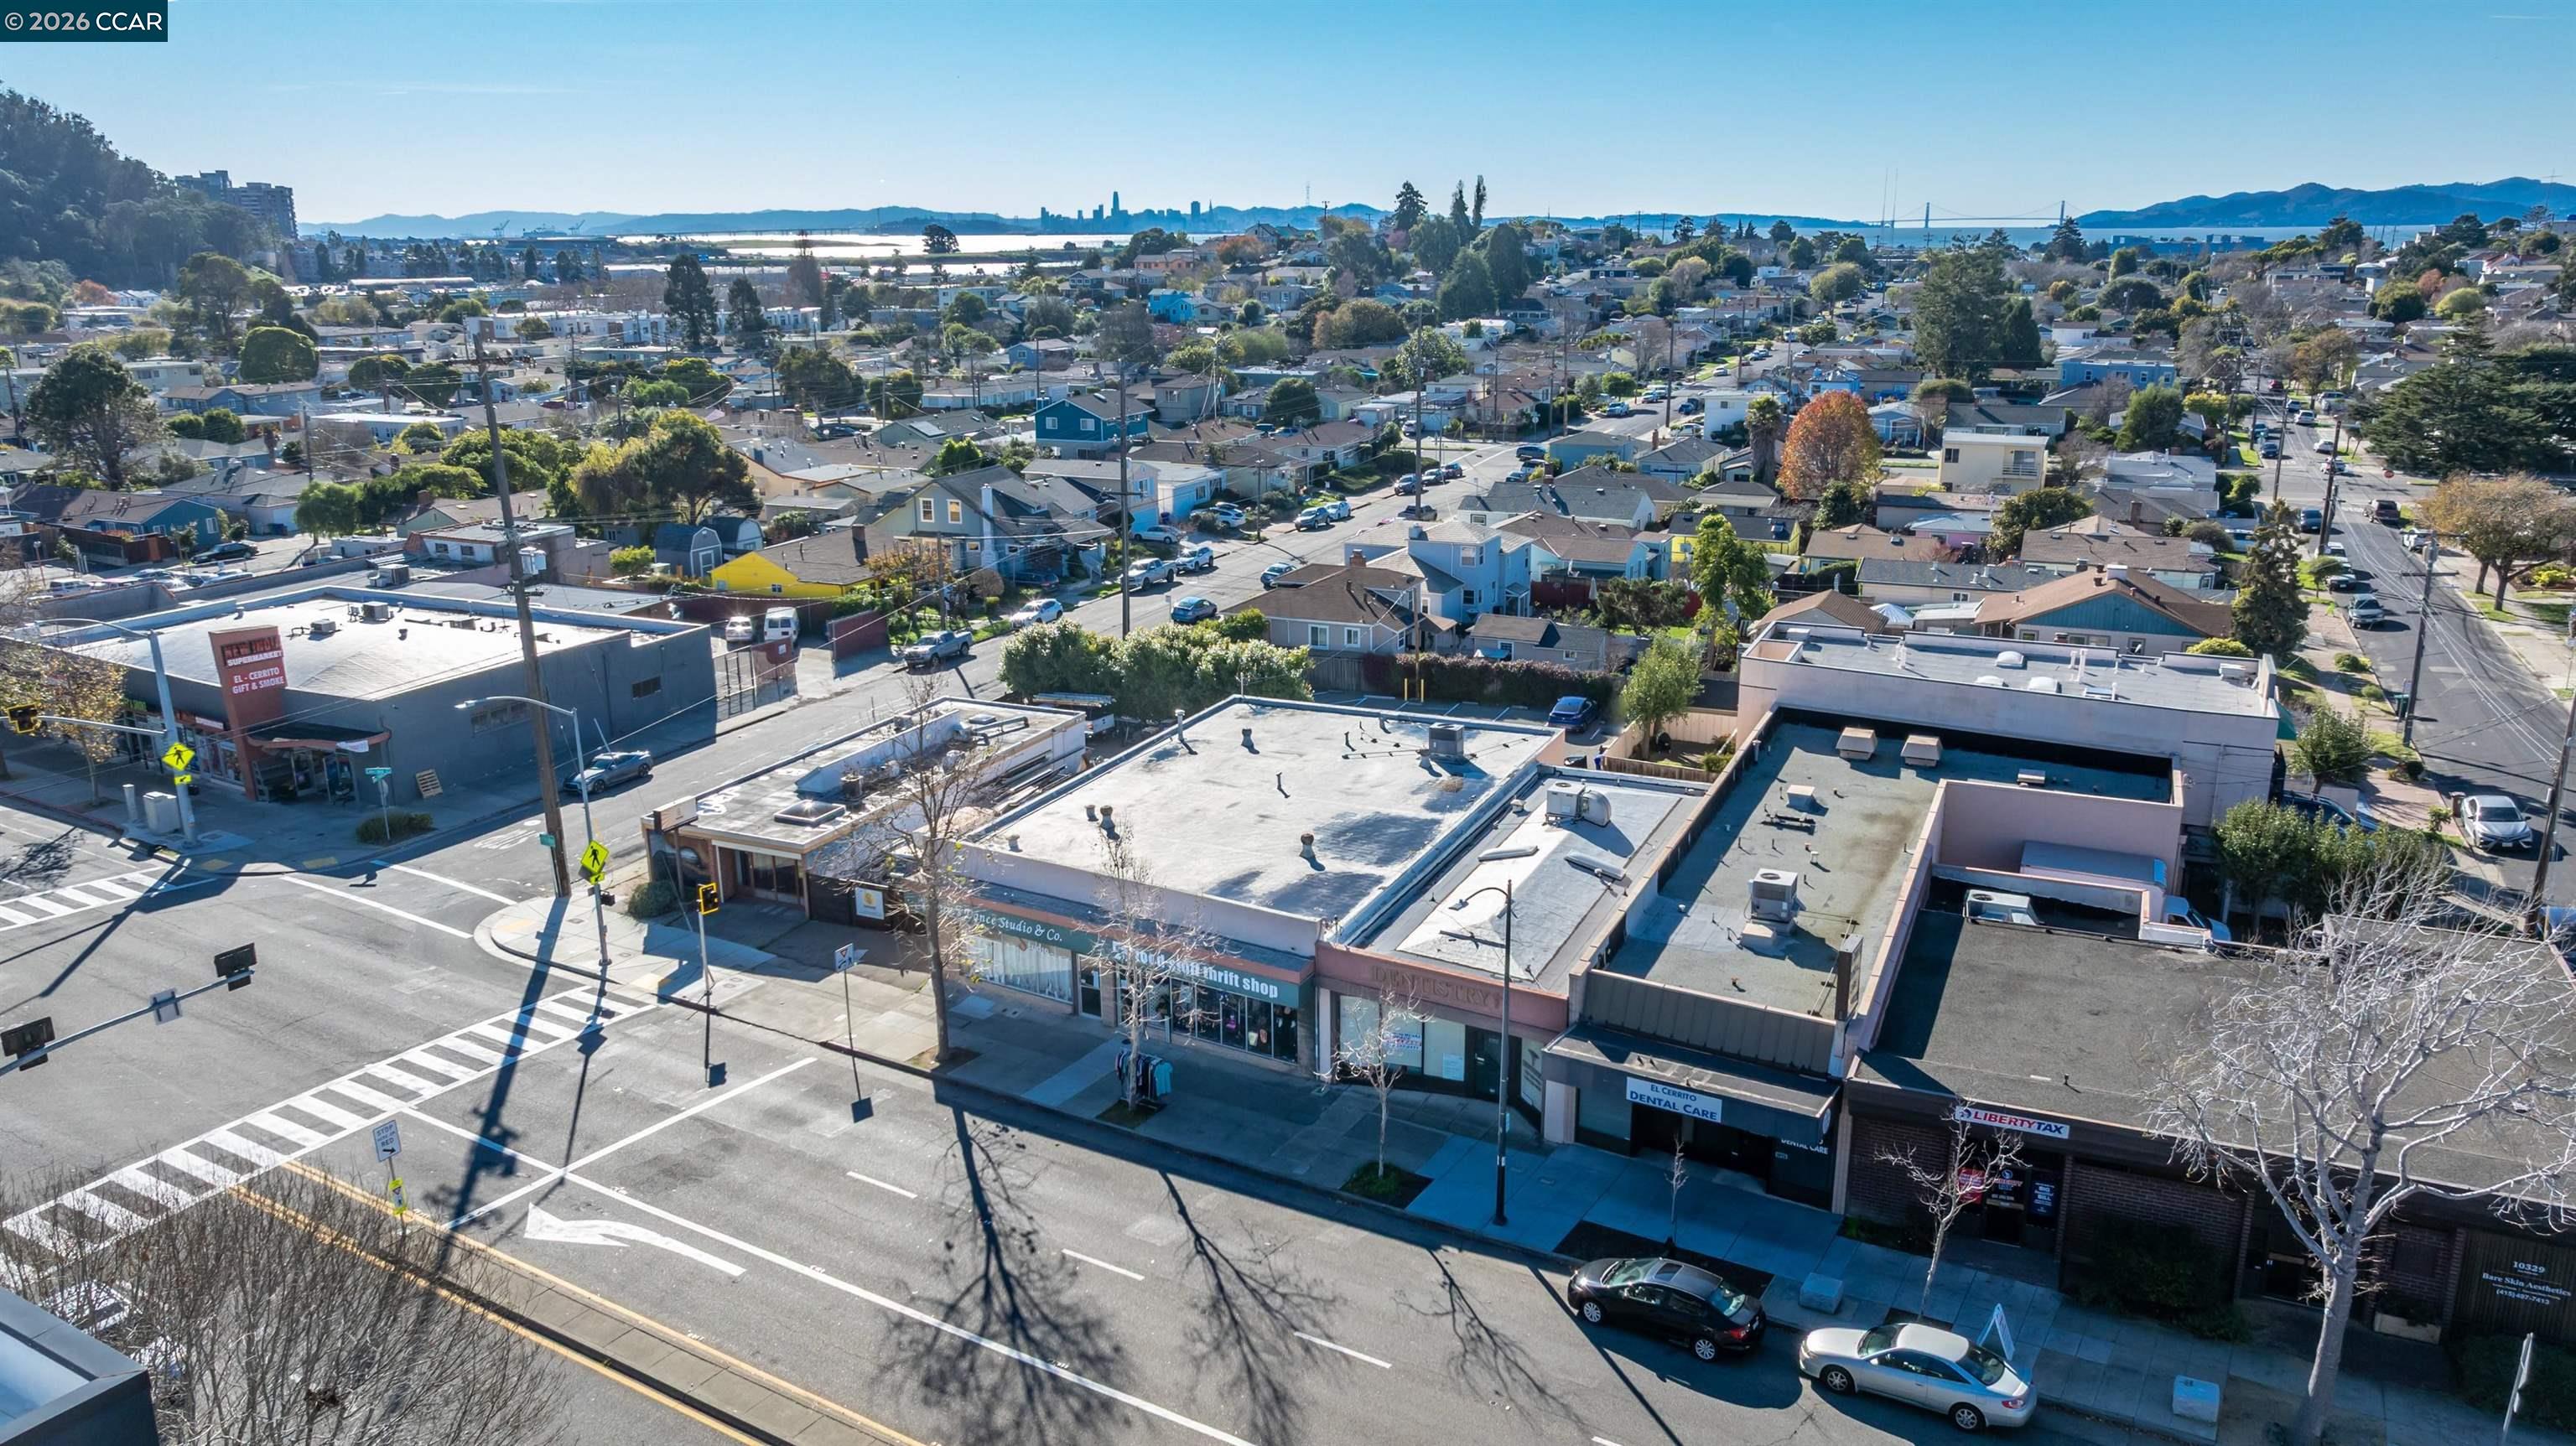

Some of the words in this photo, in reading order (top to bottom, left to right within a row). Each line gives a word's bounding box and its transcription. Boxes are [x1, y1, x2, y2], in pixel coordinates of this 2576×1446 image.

[227, 650, 283, 666] SUPERMARKET
[233, 675, 243, 683] EL
[249, 666, 280, 680] CERRITO
[232, 683, 249, 694] GIFT
[252, 682, 257, 690] &
[259, 676, 284, 688] SMOKE
[998, 916, 1032, 934] Studio
[1034, 924, 1045, 936] &
[1046, 929, 1062, 941] Co.
[1204, 965, 1239, 987] thrift
[1243, 977, 1279, 998] shop
[1372, 966, 1490, 1005] DENTISTRY
[1650, 1084, 1660, 1093] EL
[1662, 1086, 1696, 1101] CERRITO
[1630, 1091, 1680, 1111] DENTAL
[1683, 1104, 1718, 1121] CARE
[377, 1124, 393, 1137] STOP
[381, 1138, 394, 1147] RED
[2513, 1261, 2545, 1273] 10329
[2482, 1272, 2503, 1283] Bare
[2504, 1277, 2525, 1288] Skin
[2526, 1282, 2572, 1297] Aesthetics
